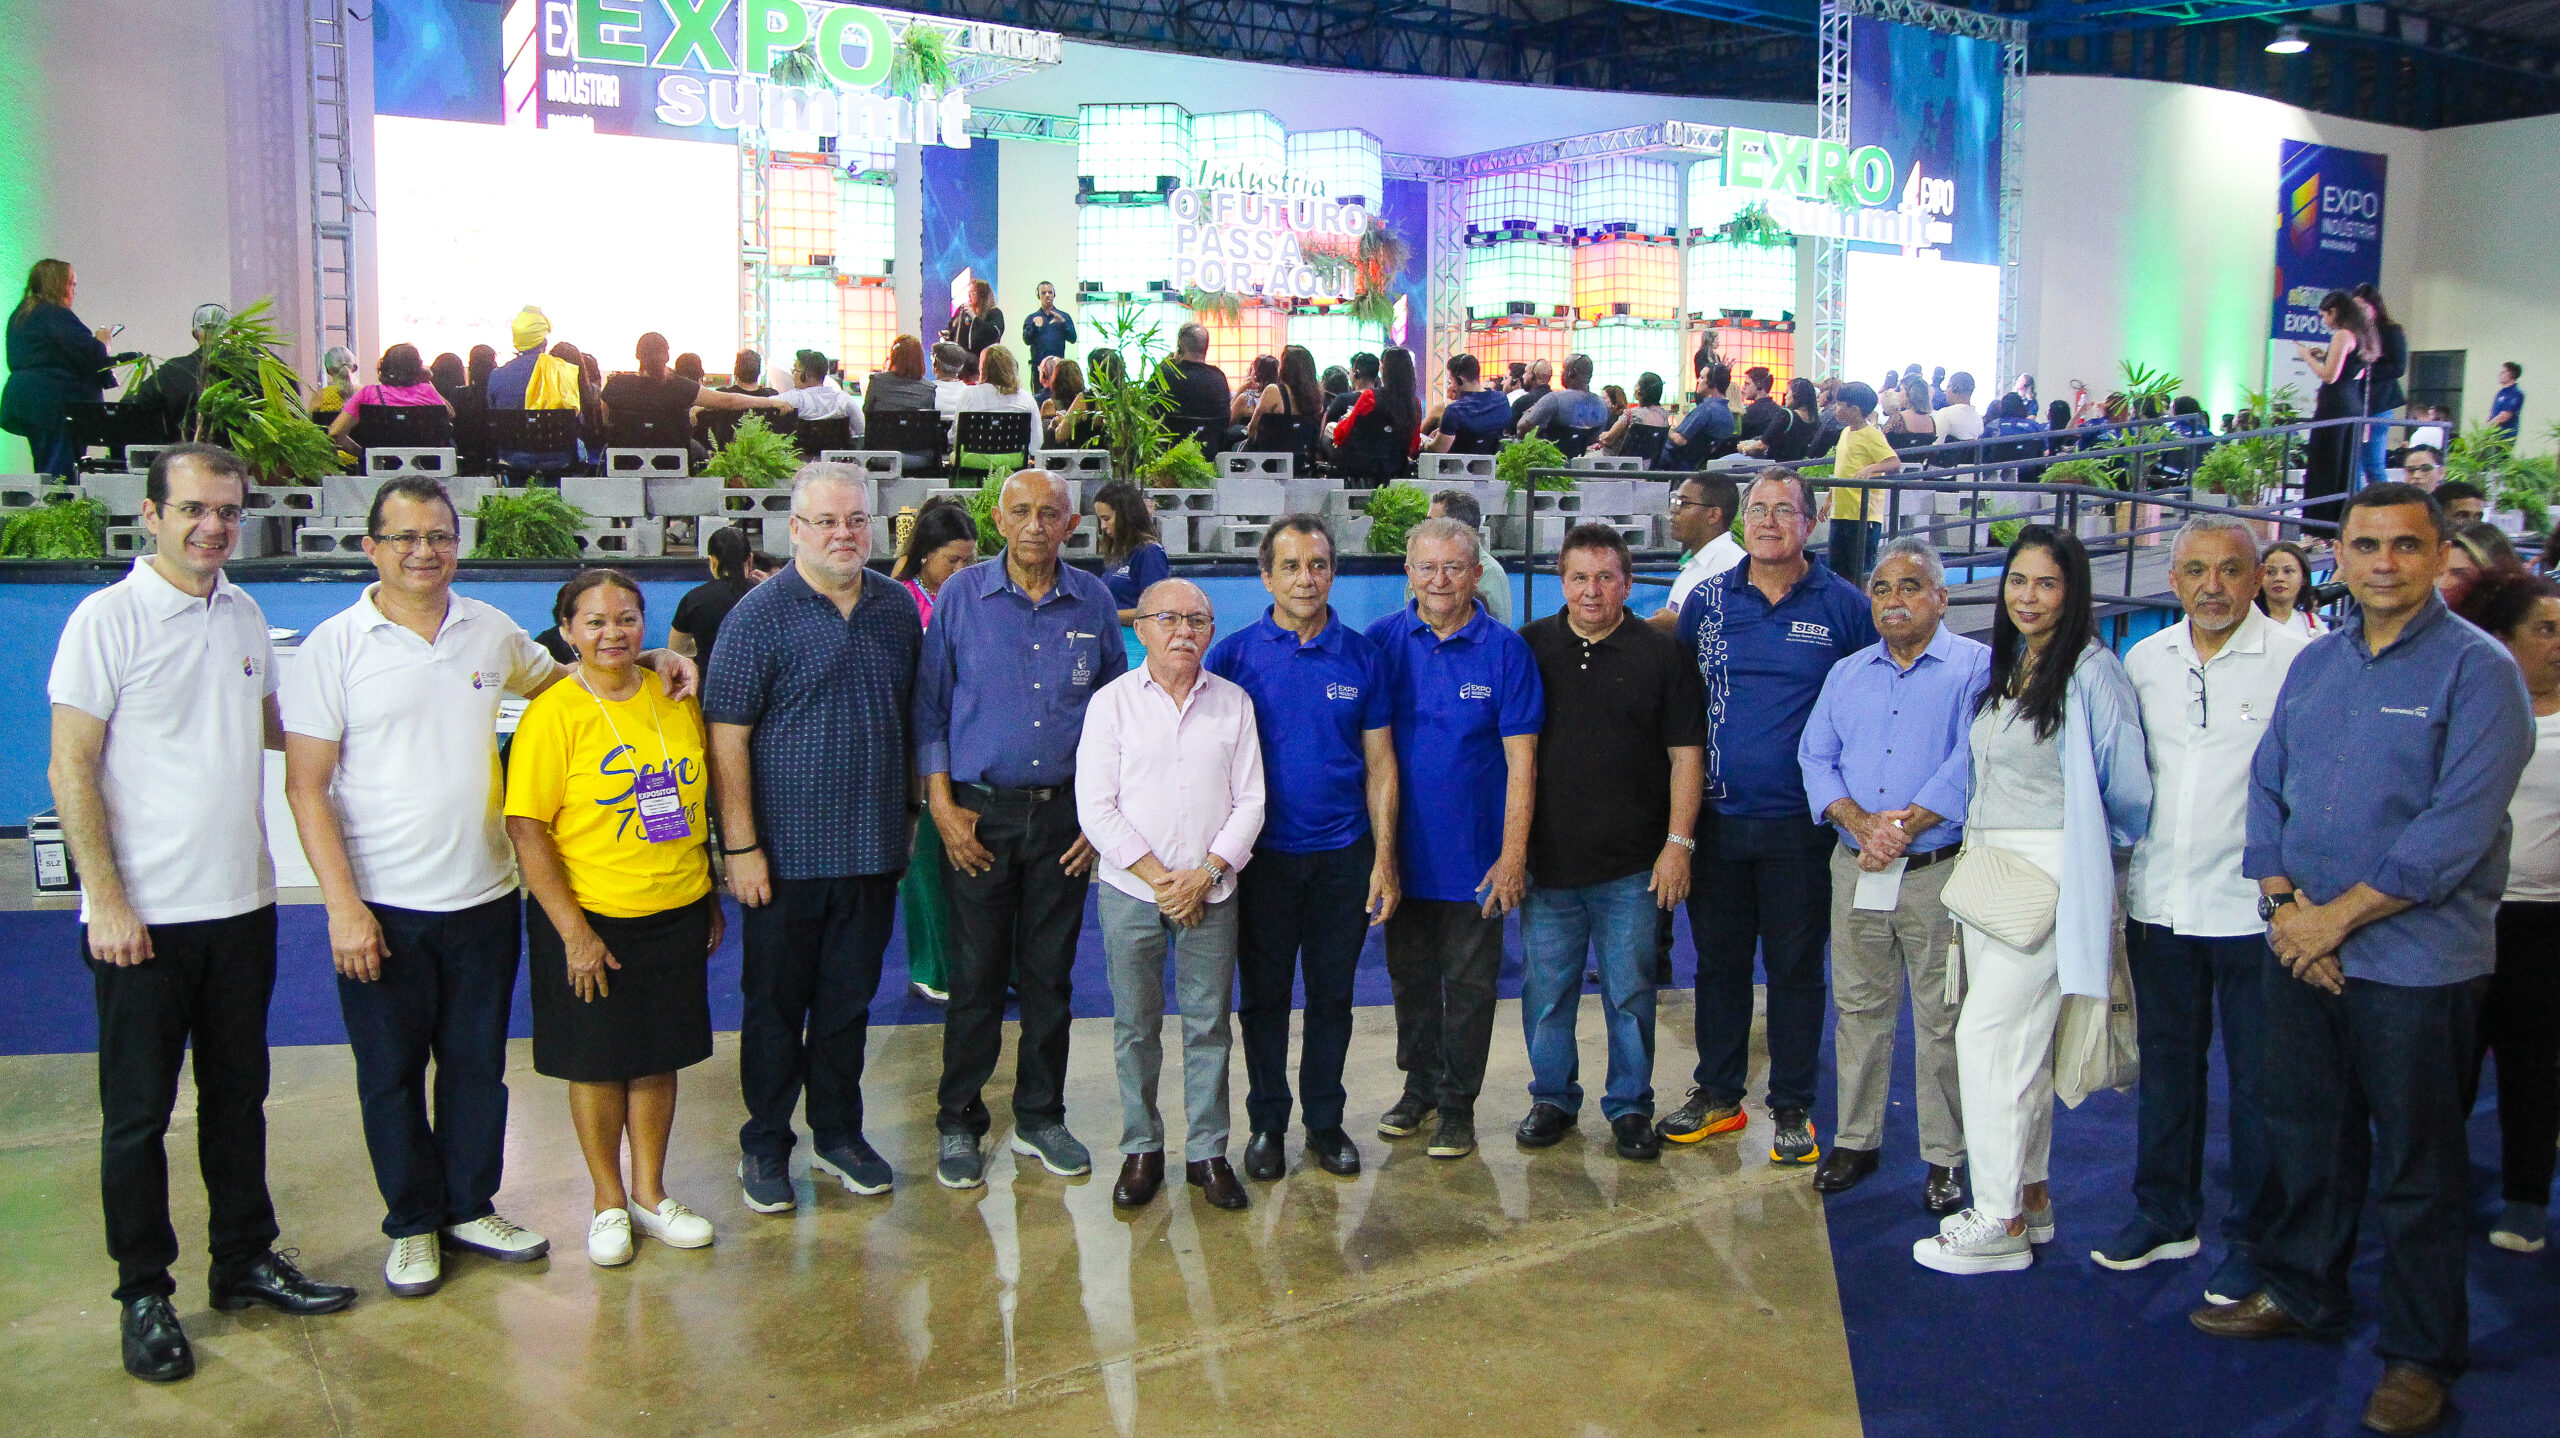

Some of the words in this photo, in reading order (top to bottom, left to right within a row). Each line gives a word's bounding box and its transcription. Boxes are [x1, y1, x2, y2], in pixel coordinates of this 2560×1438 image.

[571, 0, 895, 89] EXPO
[546, 64, 621, 108] INDÚSTRIA
[655, 74, 971, 149] summit
[1198, 160, 1326, 198] Indústria
[1728, 127, 1895, 206] EXPO
[1172, 188, 1201, 222] O
[1213, 192, 1368, 236] FUTURO
[1766, 196, 1932, 247] summit
[2323, 186, 2378, 218] EXPO
[1175, 223, 1303, 264] PASSA
[1174, 257, 1255, 295] POR
[1266, 263, 1357, 299] AQUI
[2284, 313, 2319, 334] EXPO
[1338, 685, 1358, 694] EXPO
[1470, 684, 1491, 693] EXPO
[638, 787, 677, 800] EXPOSITOR
[45, 859, 61, 867] SLZ
